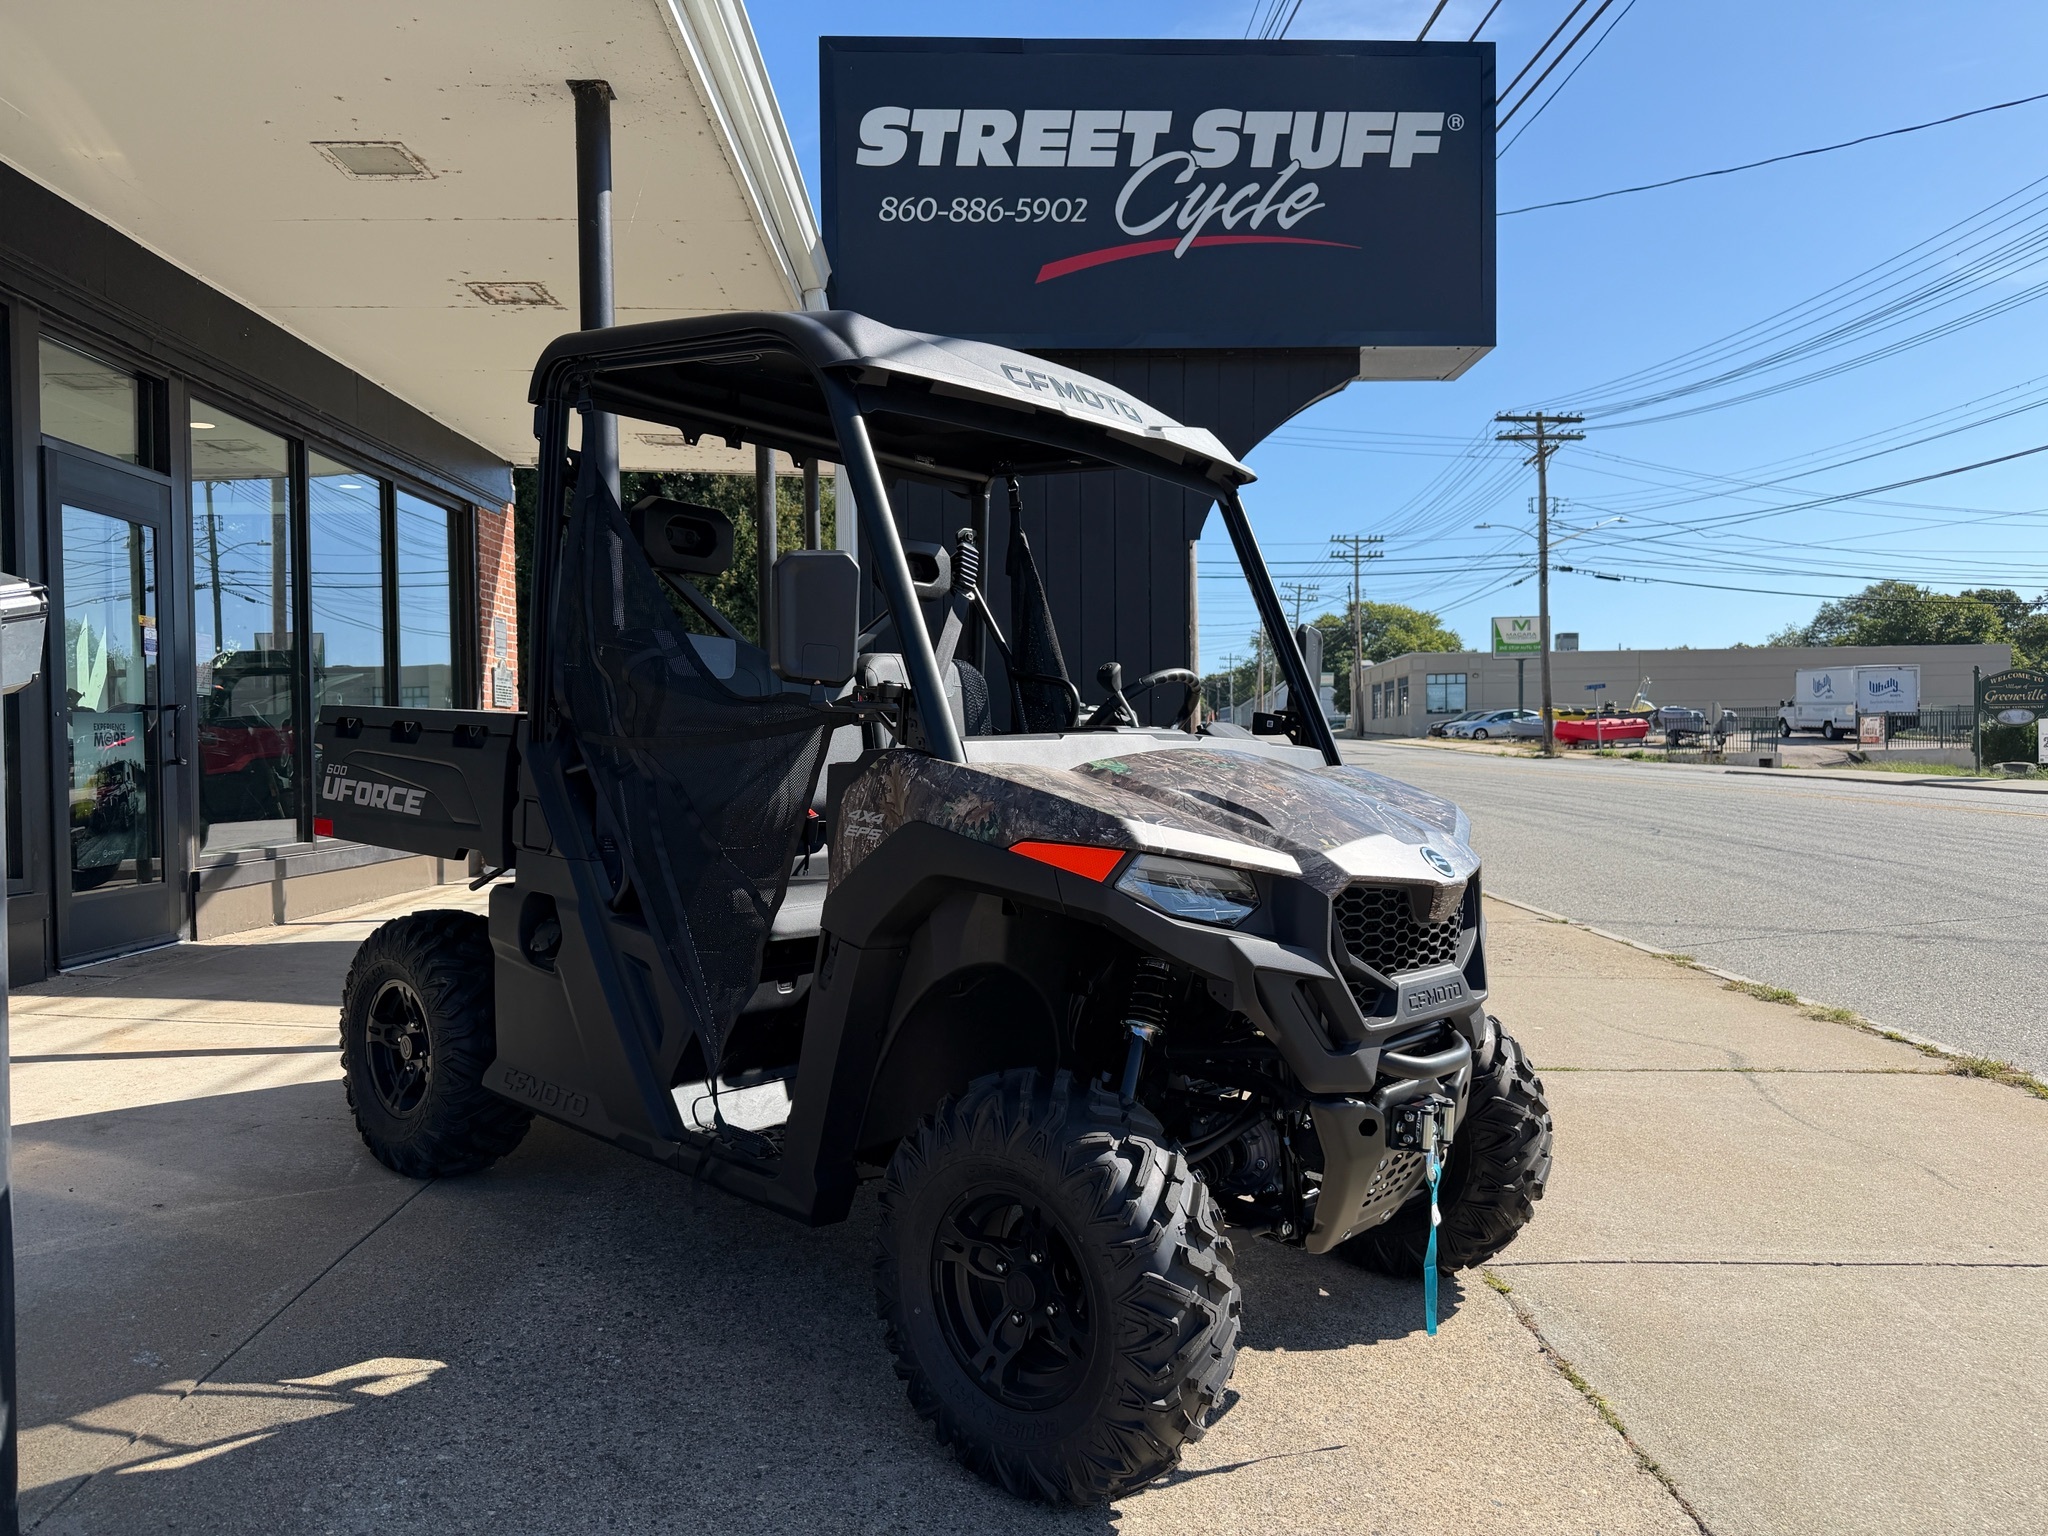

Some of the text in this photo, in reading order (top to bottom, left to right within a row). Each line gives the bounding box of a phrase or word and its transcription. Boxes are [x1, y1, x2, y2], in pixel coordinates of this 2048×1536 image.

[856, 106, 1173, 167] STREET
[1191, 108, 1445, 169] STUFF
[878, 196, 1089, 223] 860-886-5902
[1115, 151, 1326, 259] Cycle
[1000, 362, 1143, 424] CFMOTO
[1869, 677, 1899, 693] Whaly
[1990, 672, 2044, 684] WELCOME TO
[1984, 689, 2047, 704] Greeneville
[93, 723, 126, 731] EXPERIENCE
[326, 763, 348, 776] 600
[322, 775, 427, 816] UFORCE
[847, 809, 885, 825] 4X4
[843, 825, 884, 840] EPS
[1408, 981, 1463, 1012] CFMOTO
[504, 1066, 589, 1118] CFMOTO
